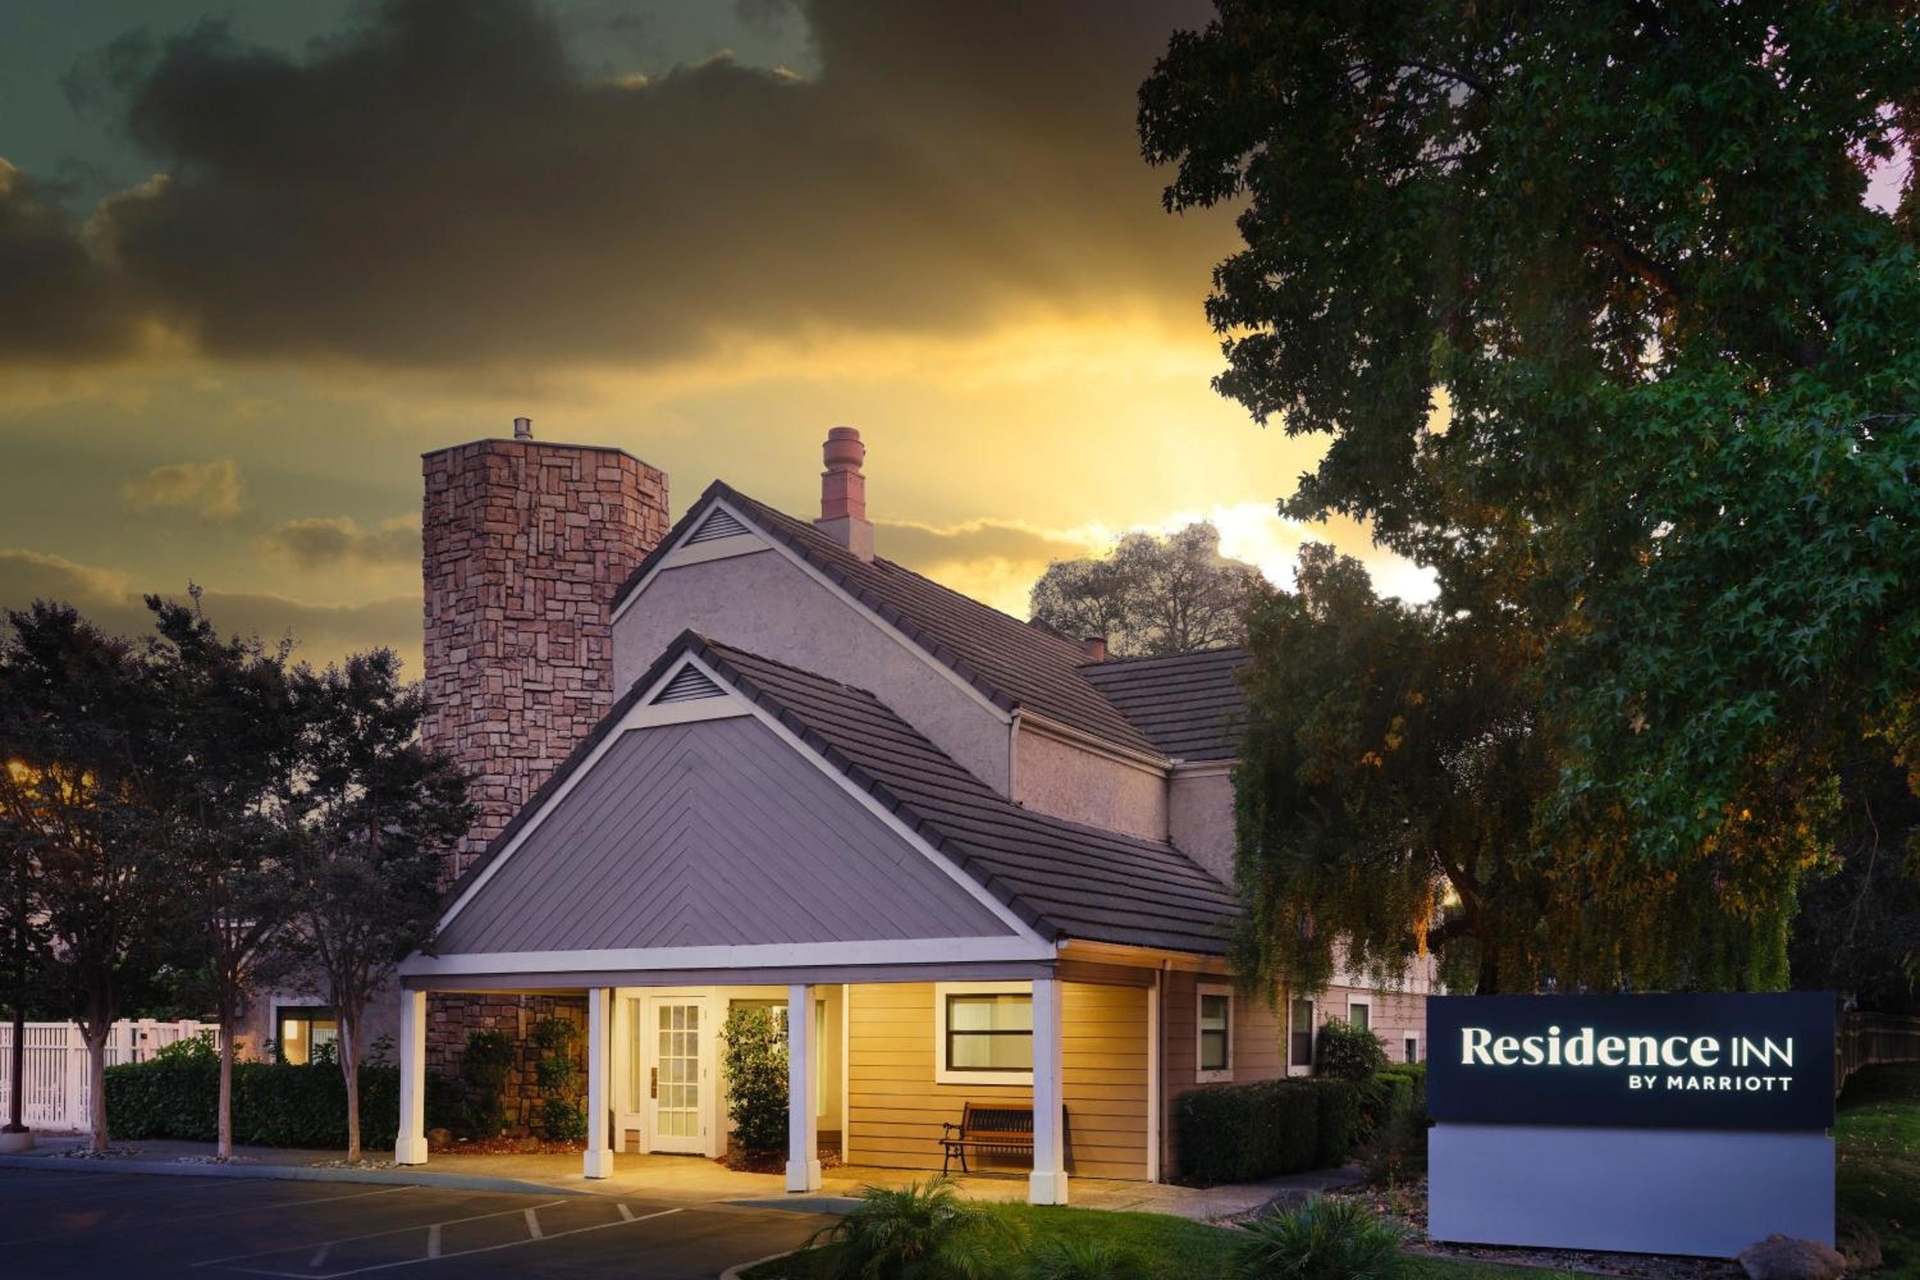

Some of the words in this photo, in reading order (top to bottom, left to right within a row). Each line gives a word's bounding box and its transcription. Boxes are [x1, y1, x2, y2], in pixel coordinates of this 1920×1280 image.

[1461, 1026, 1720, 1067] Residence
[1731, 1037, 1793, 1068] INN
[1628, 1075, 1657, 1089] BY
[1667, 1075, 1793, 1091] MARRIOTT
